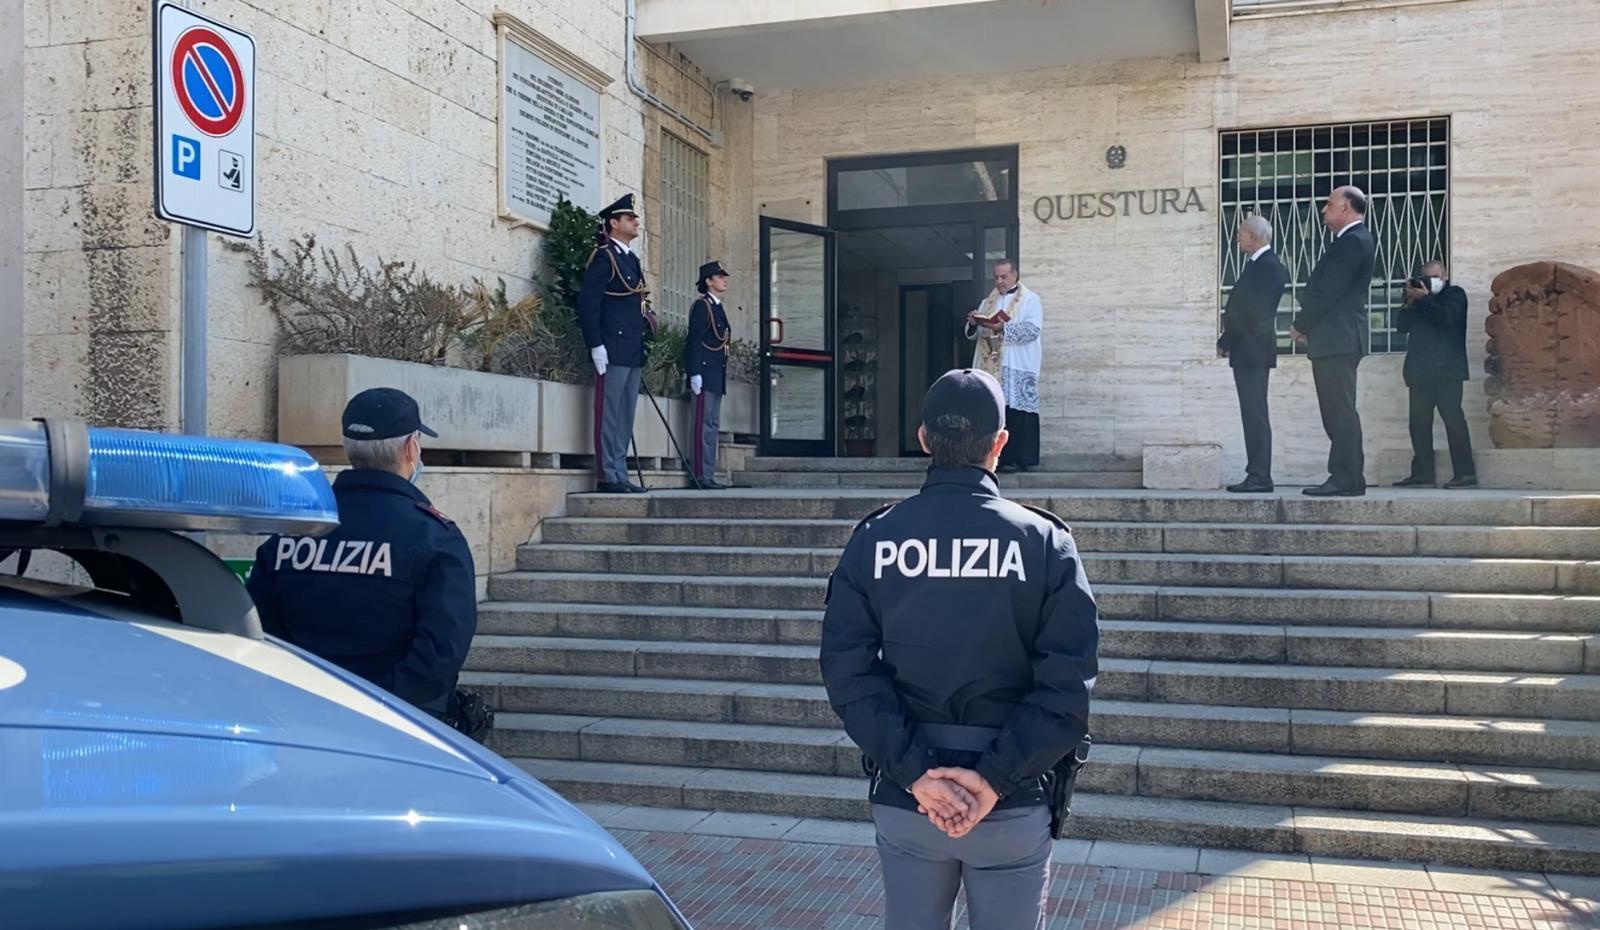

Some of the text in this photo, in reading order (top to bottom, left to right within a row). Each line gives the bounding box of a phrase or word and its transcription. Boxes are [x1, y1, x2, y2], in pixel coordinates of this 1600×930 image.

[178, 140, 196, 172] P
[1033, 186, 1206, 224] QUESTURA
[274, 536, 392, 577] POLIZIA
[874, 538, 1027, 582] POLIZIA
